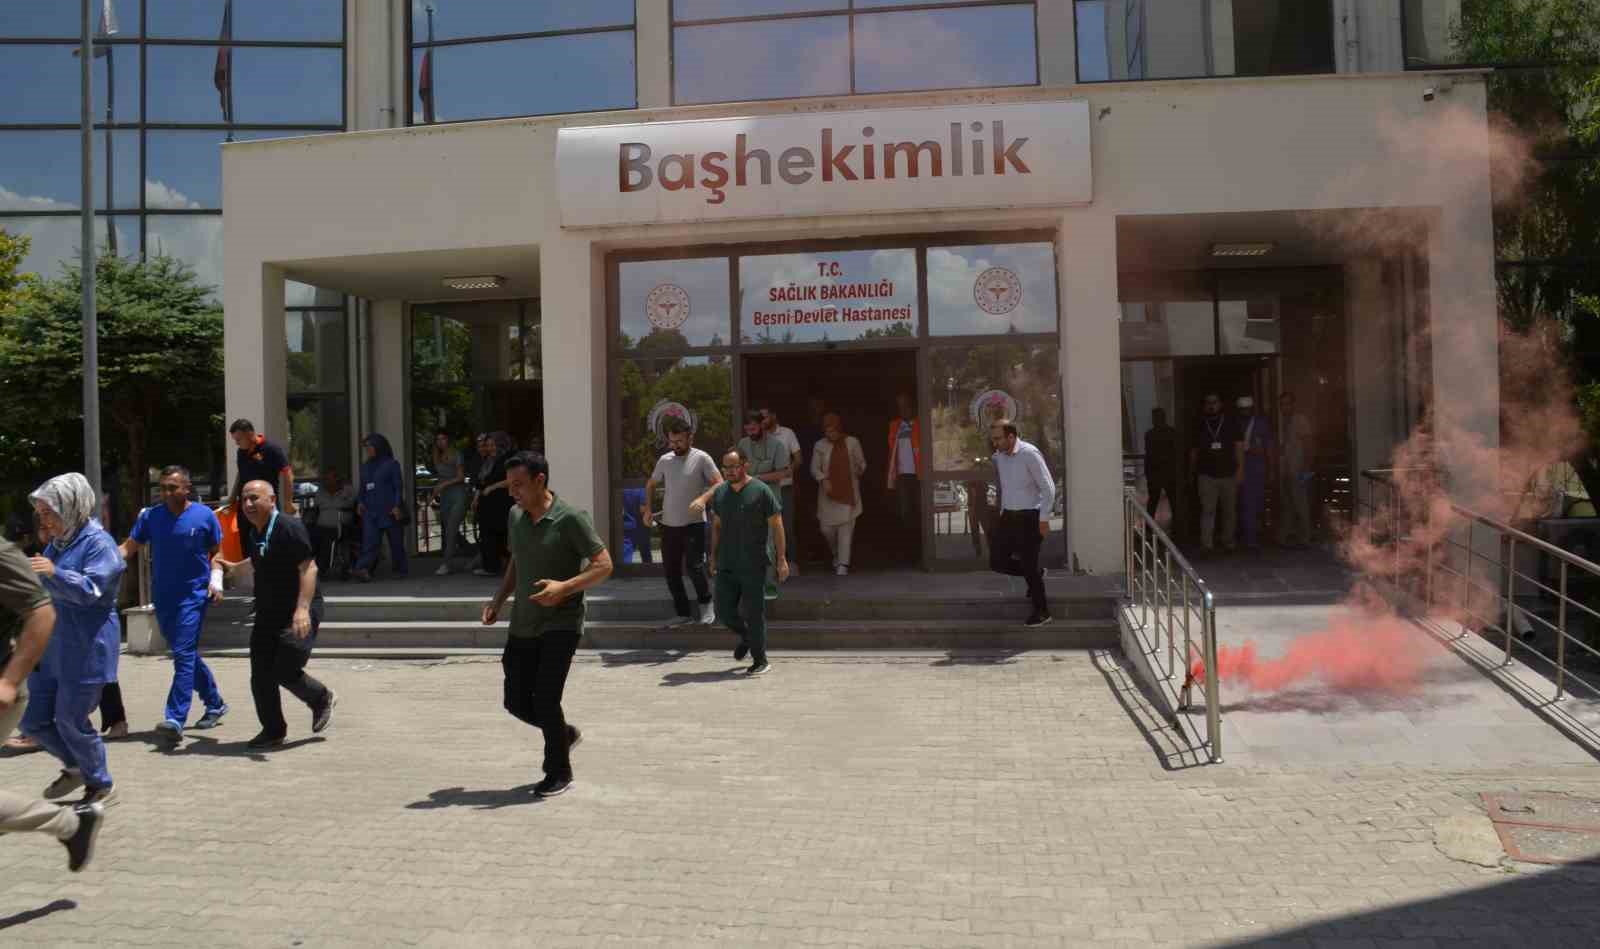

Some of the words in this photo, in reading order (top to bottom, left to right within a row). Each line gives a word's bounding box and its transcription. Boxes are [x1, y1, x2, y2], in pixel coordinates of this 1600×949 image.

[619, 120, 1032, 205] Başhekimlik
[817, 262, 843, 278] T.C.
[769, 283, 817, 302] SAĞLIK
[820, 279, 894, 300] BAKANLIĞI
[794, 307, 839, 324] Devlet
[842, 304, 912, 322] Hastanesi
